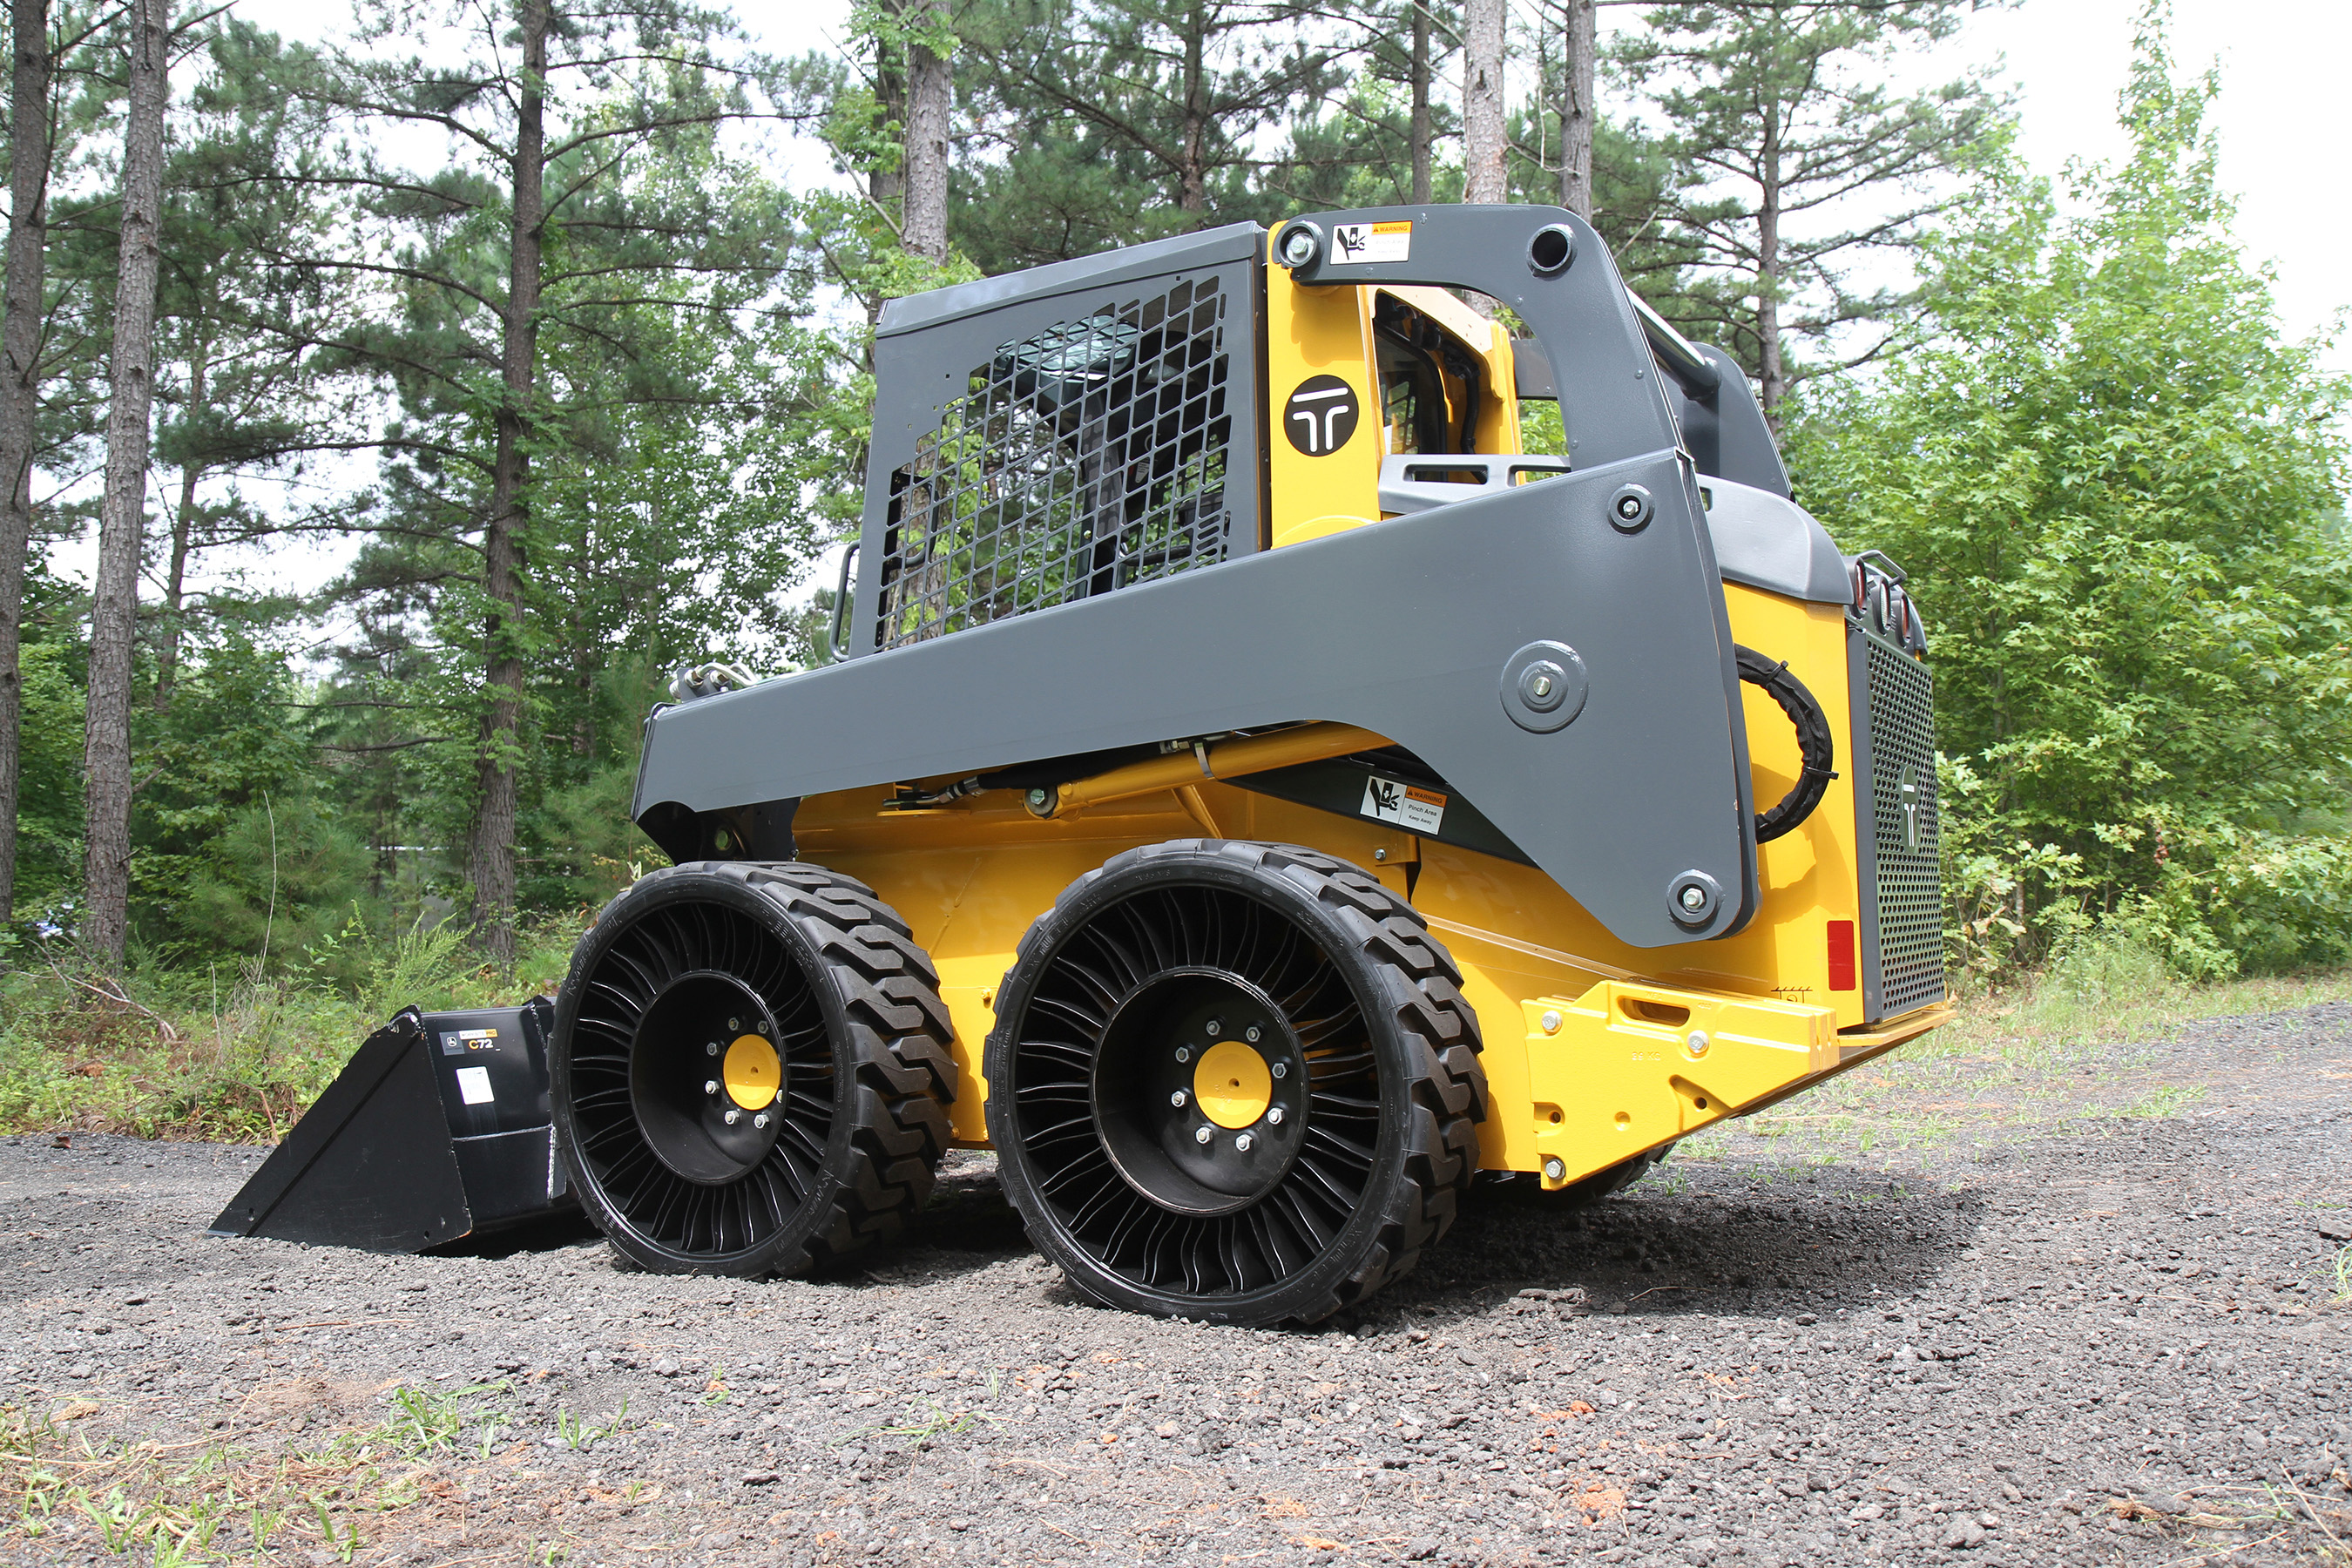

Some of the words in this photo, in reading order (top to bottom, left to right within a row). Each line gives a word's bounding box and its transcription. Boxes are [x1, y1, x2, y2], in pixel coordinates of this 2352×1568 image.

[1414, 791, 1443, 804] WARNING
[1408, 804, 1423, 814] Pinch
[1424, 808, 1437, 817] Area
[1421, 817, 1433, 826] Away
[469, 1038, 494, 1050] C72
[1647, 1051, 1661, 1061] KG
